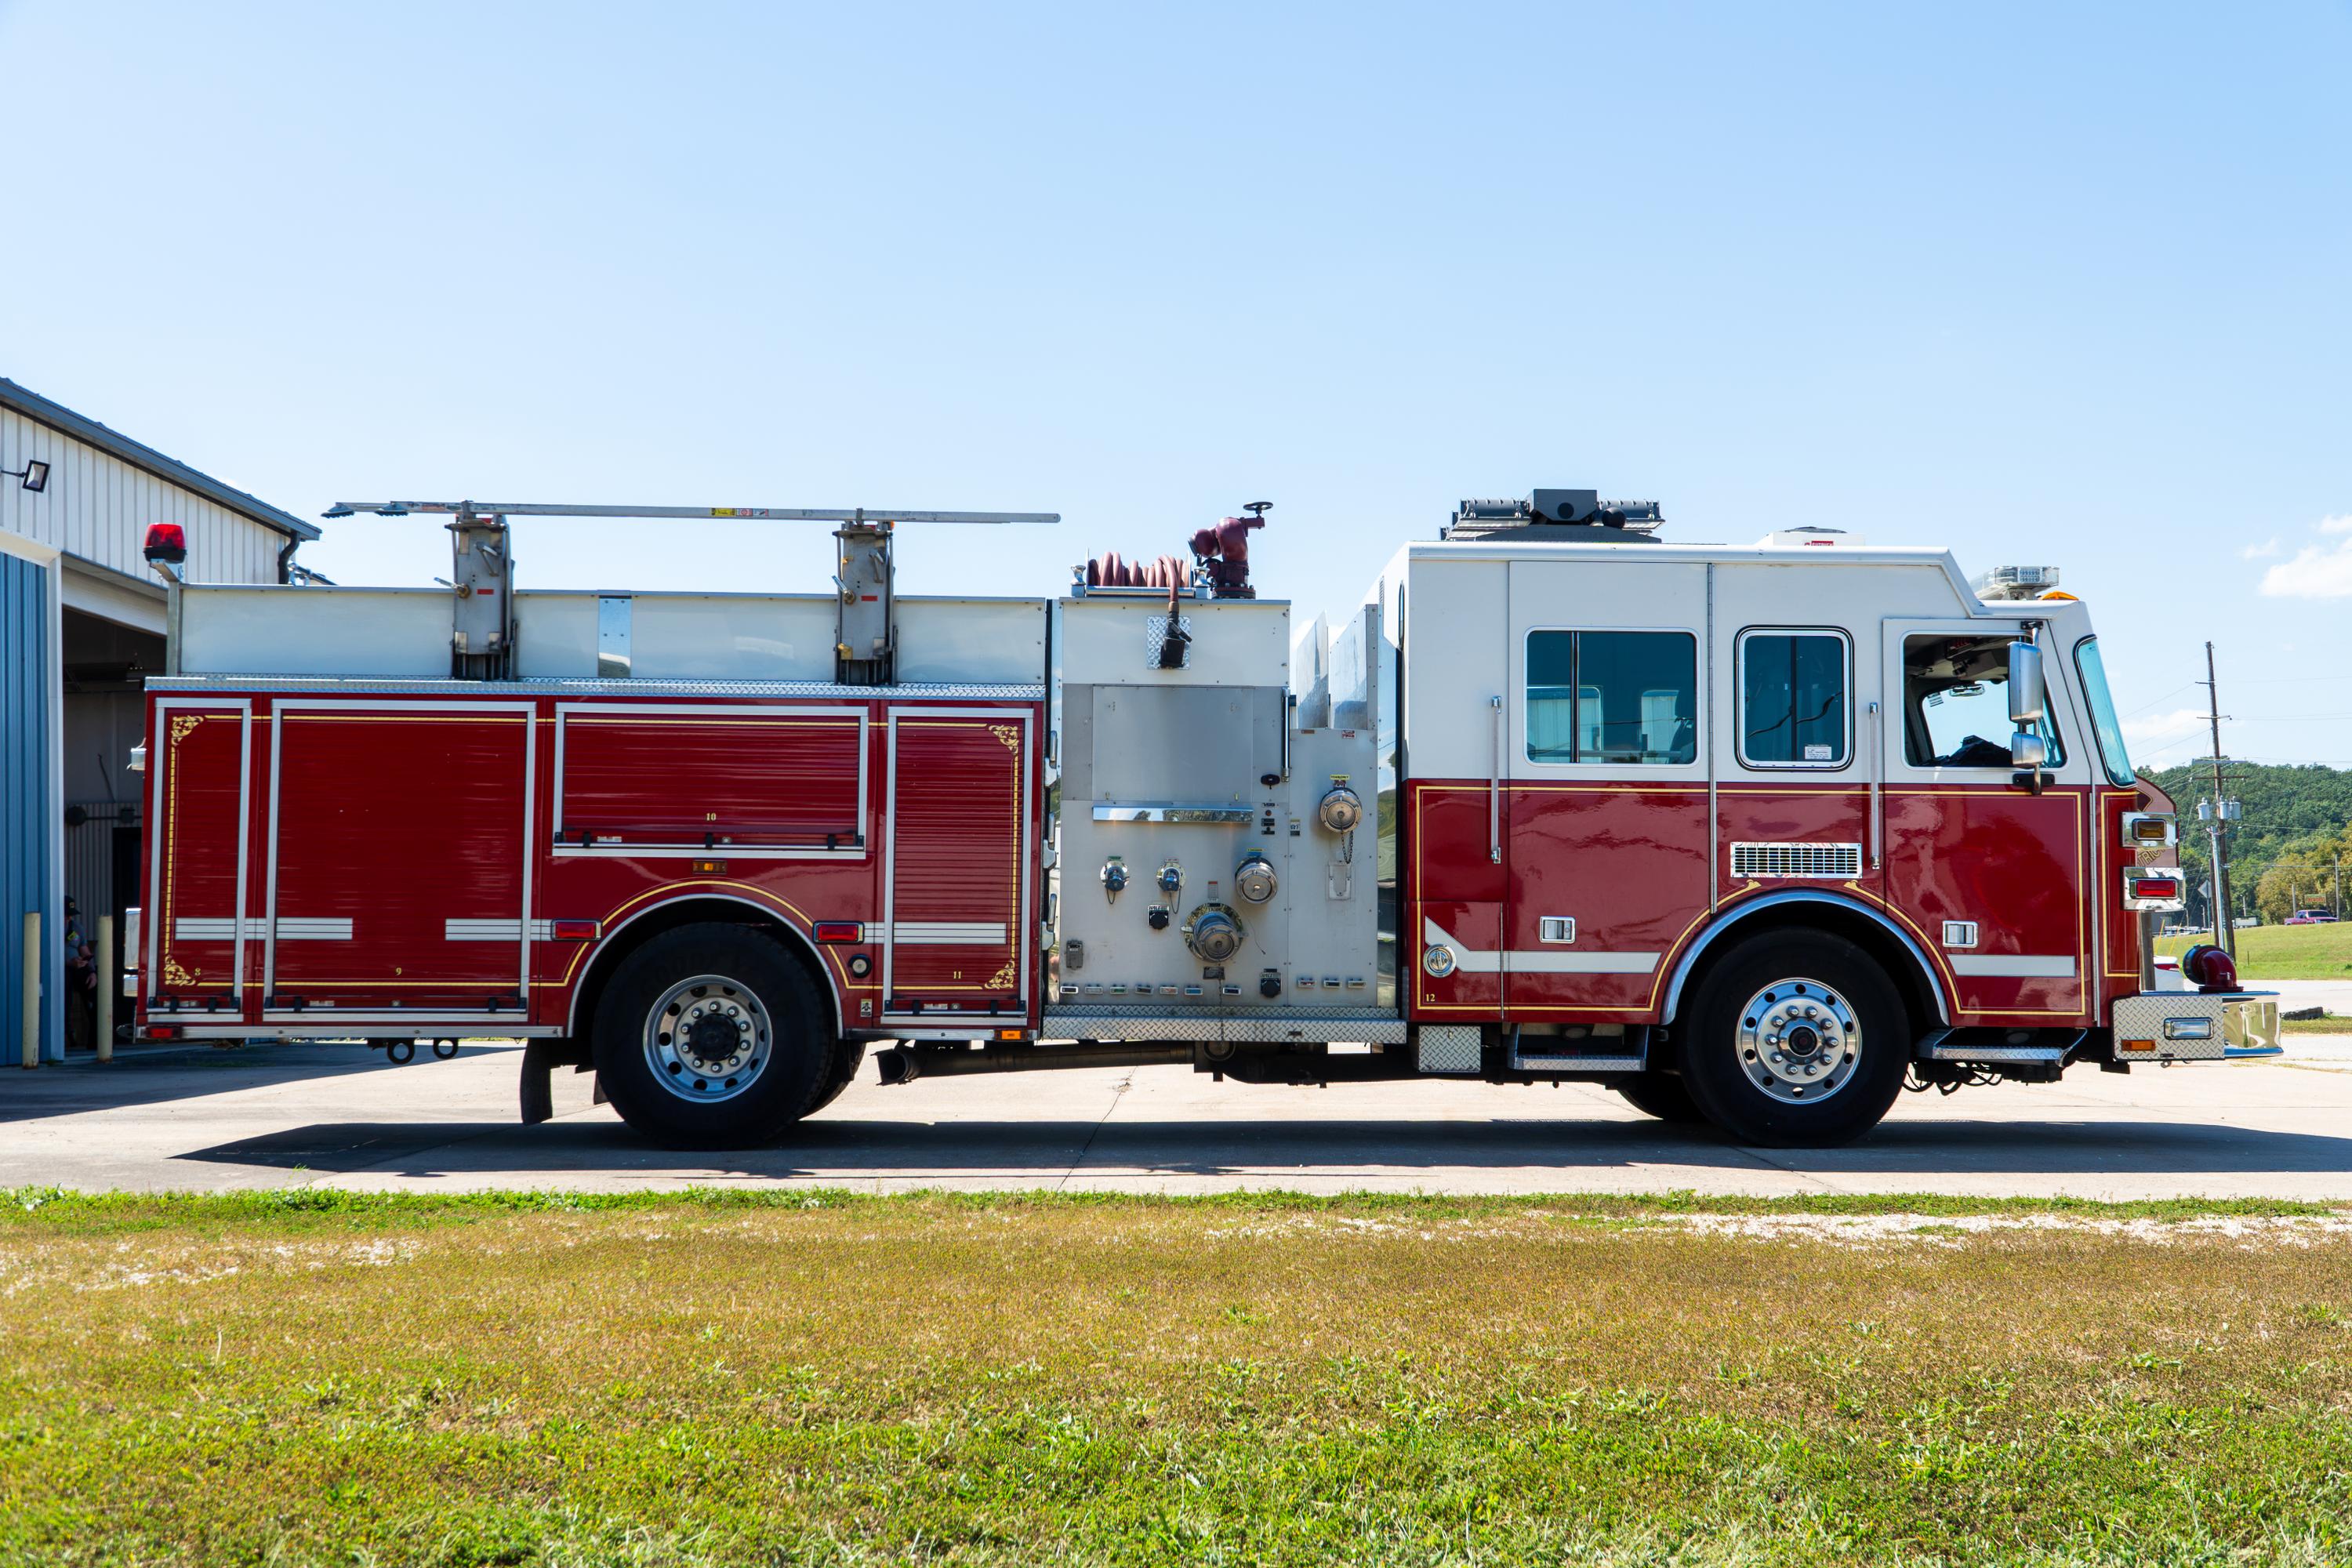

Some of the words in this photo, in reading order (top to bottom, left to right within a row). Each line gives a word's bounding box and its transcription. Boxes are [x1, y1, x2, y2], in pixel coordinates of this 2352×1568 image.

[194, 967, 201, 976] 8
[395, 967, 402, 976] 9
[953, 971, 962, 979] 11
[1425, 993, 1436, 1002] 12
